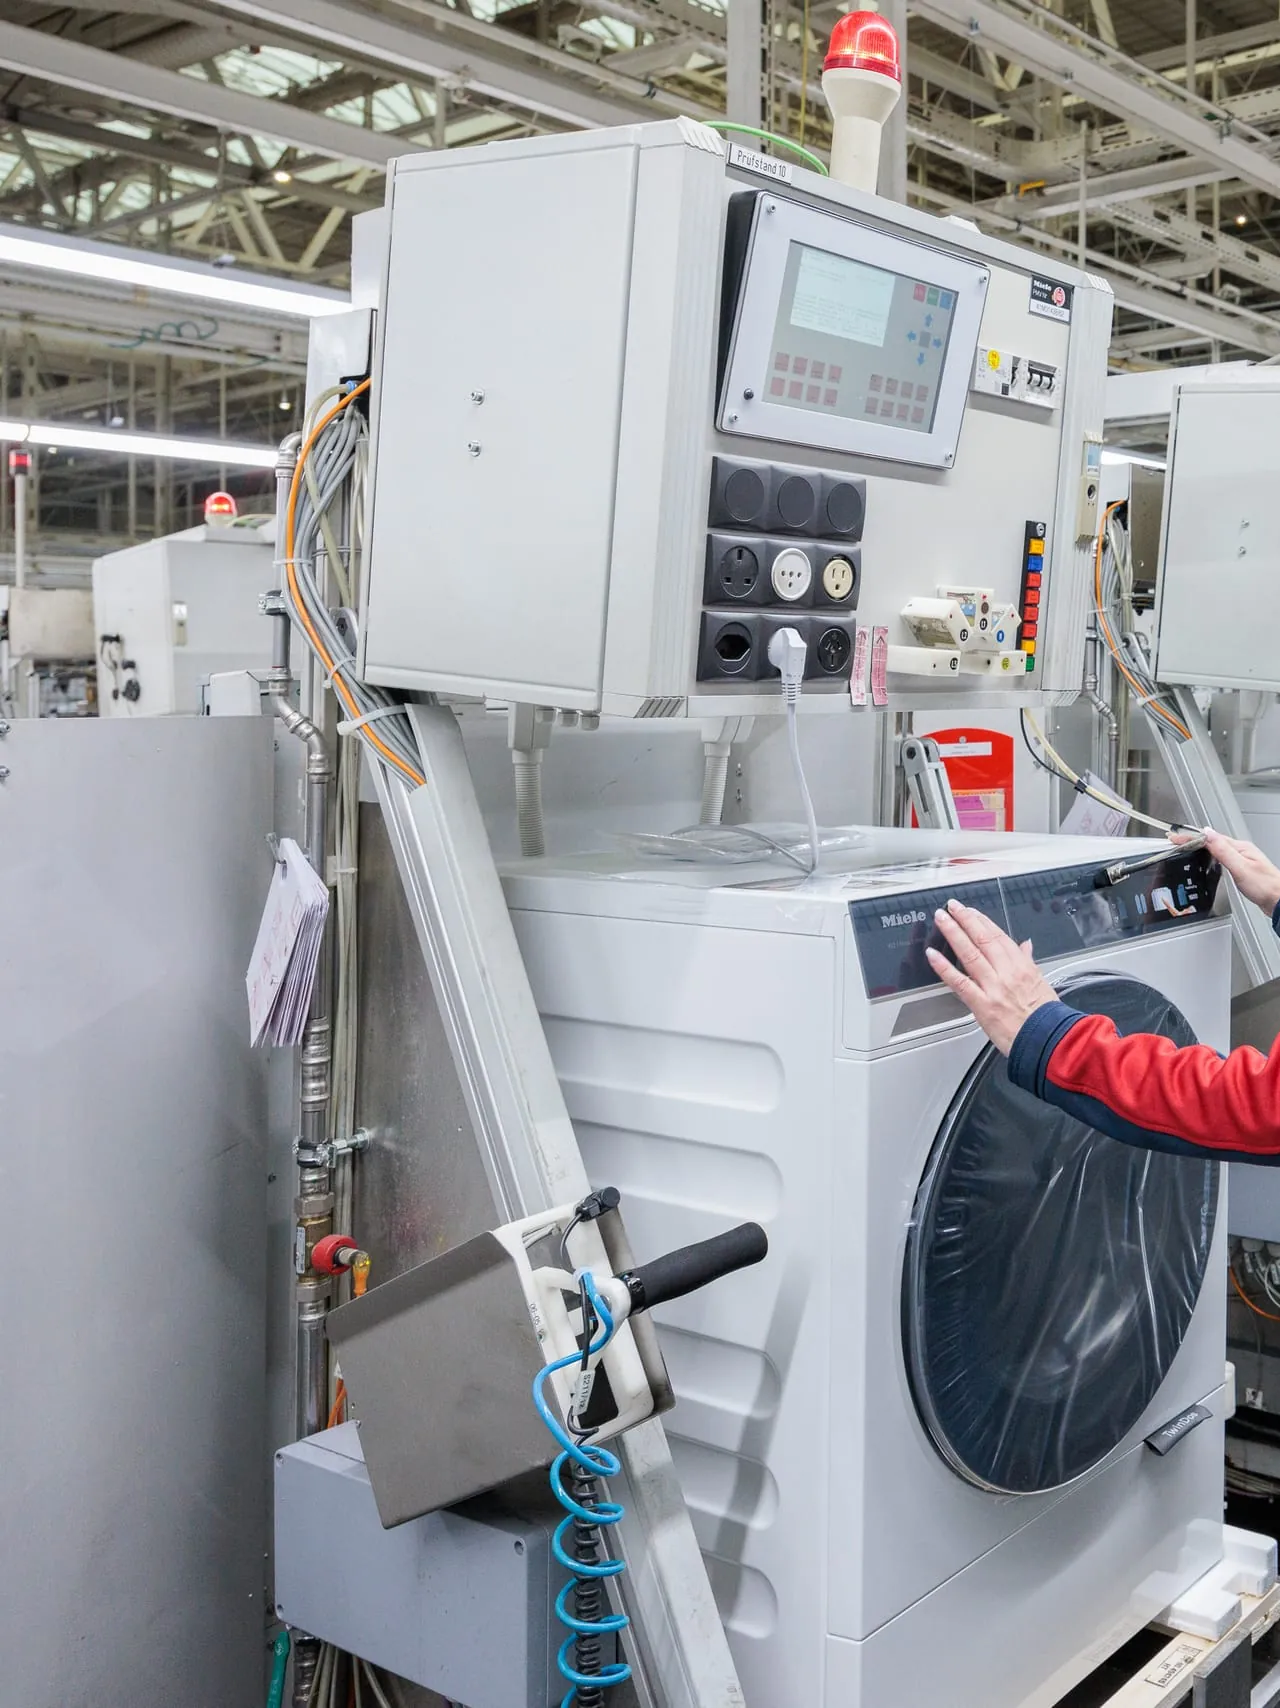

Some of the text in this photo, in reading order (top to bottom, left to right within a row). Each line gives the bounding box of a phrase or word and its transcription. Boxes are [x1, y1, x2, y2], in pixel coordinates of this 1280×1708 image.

[737, 149, 787, 178] Prüfstand 10
[880, 910, 927, 929] Miele
